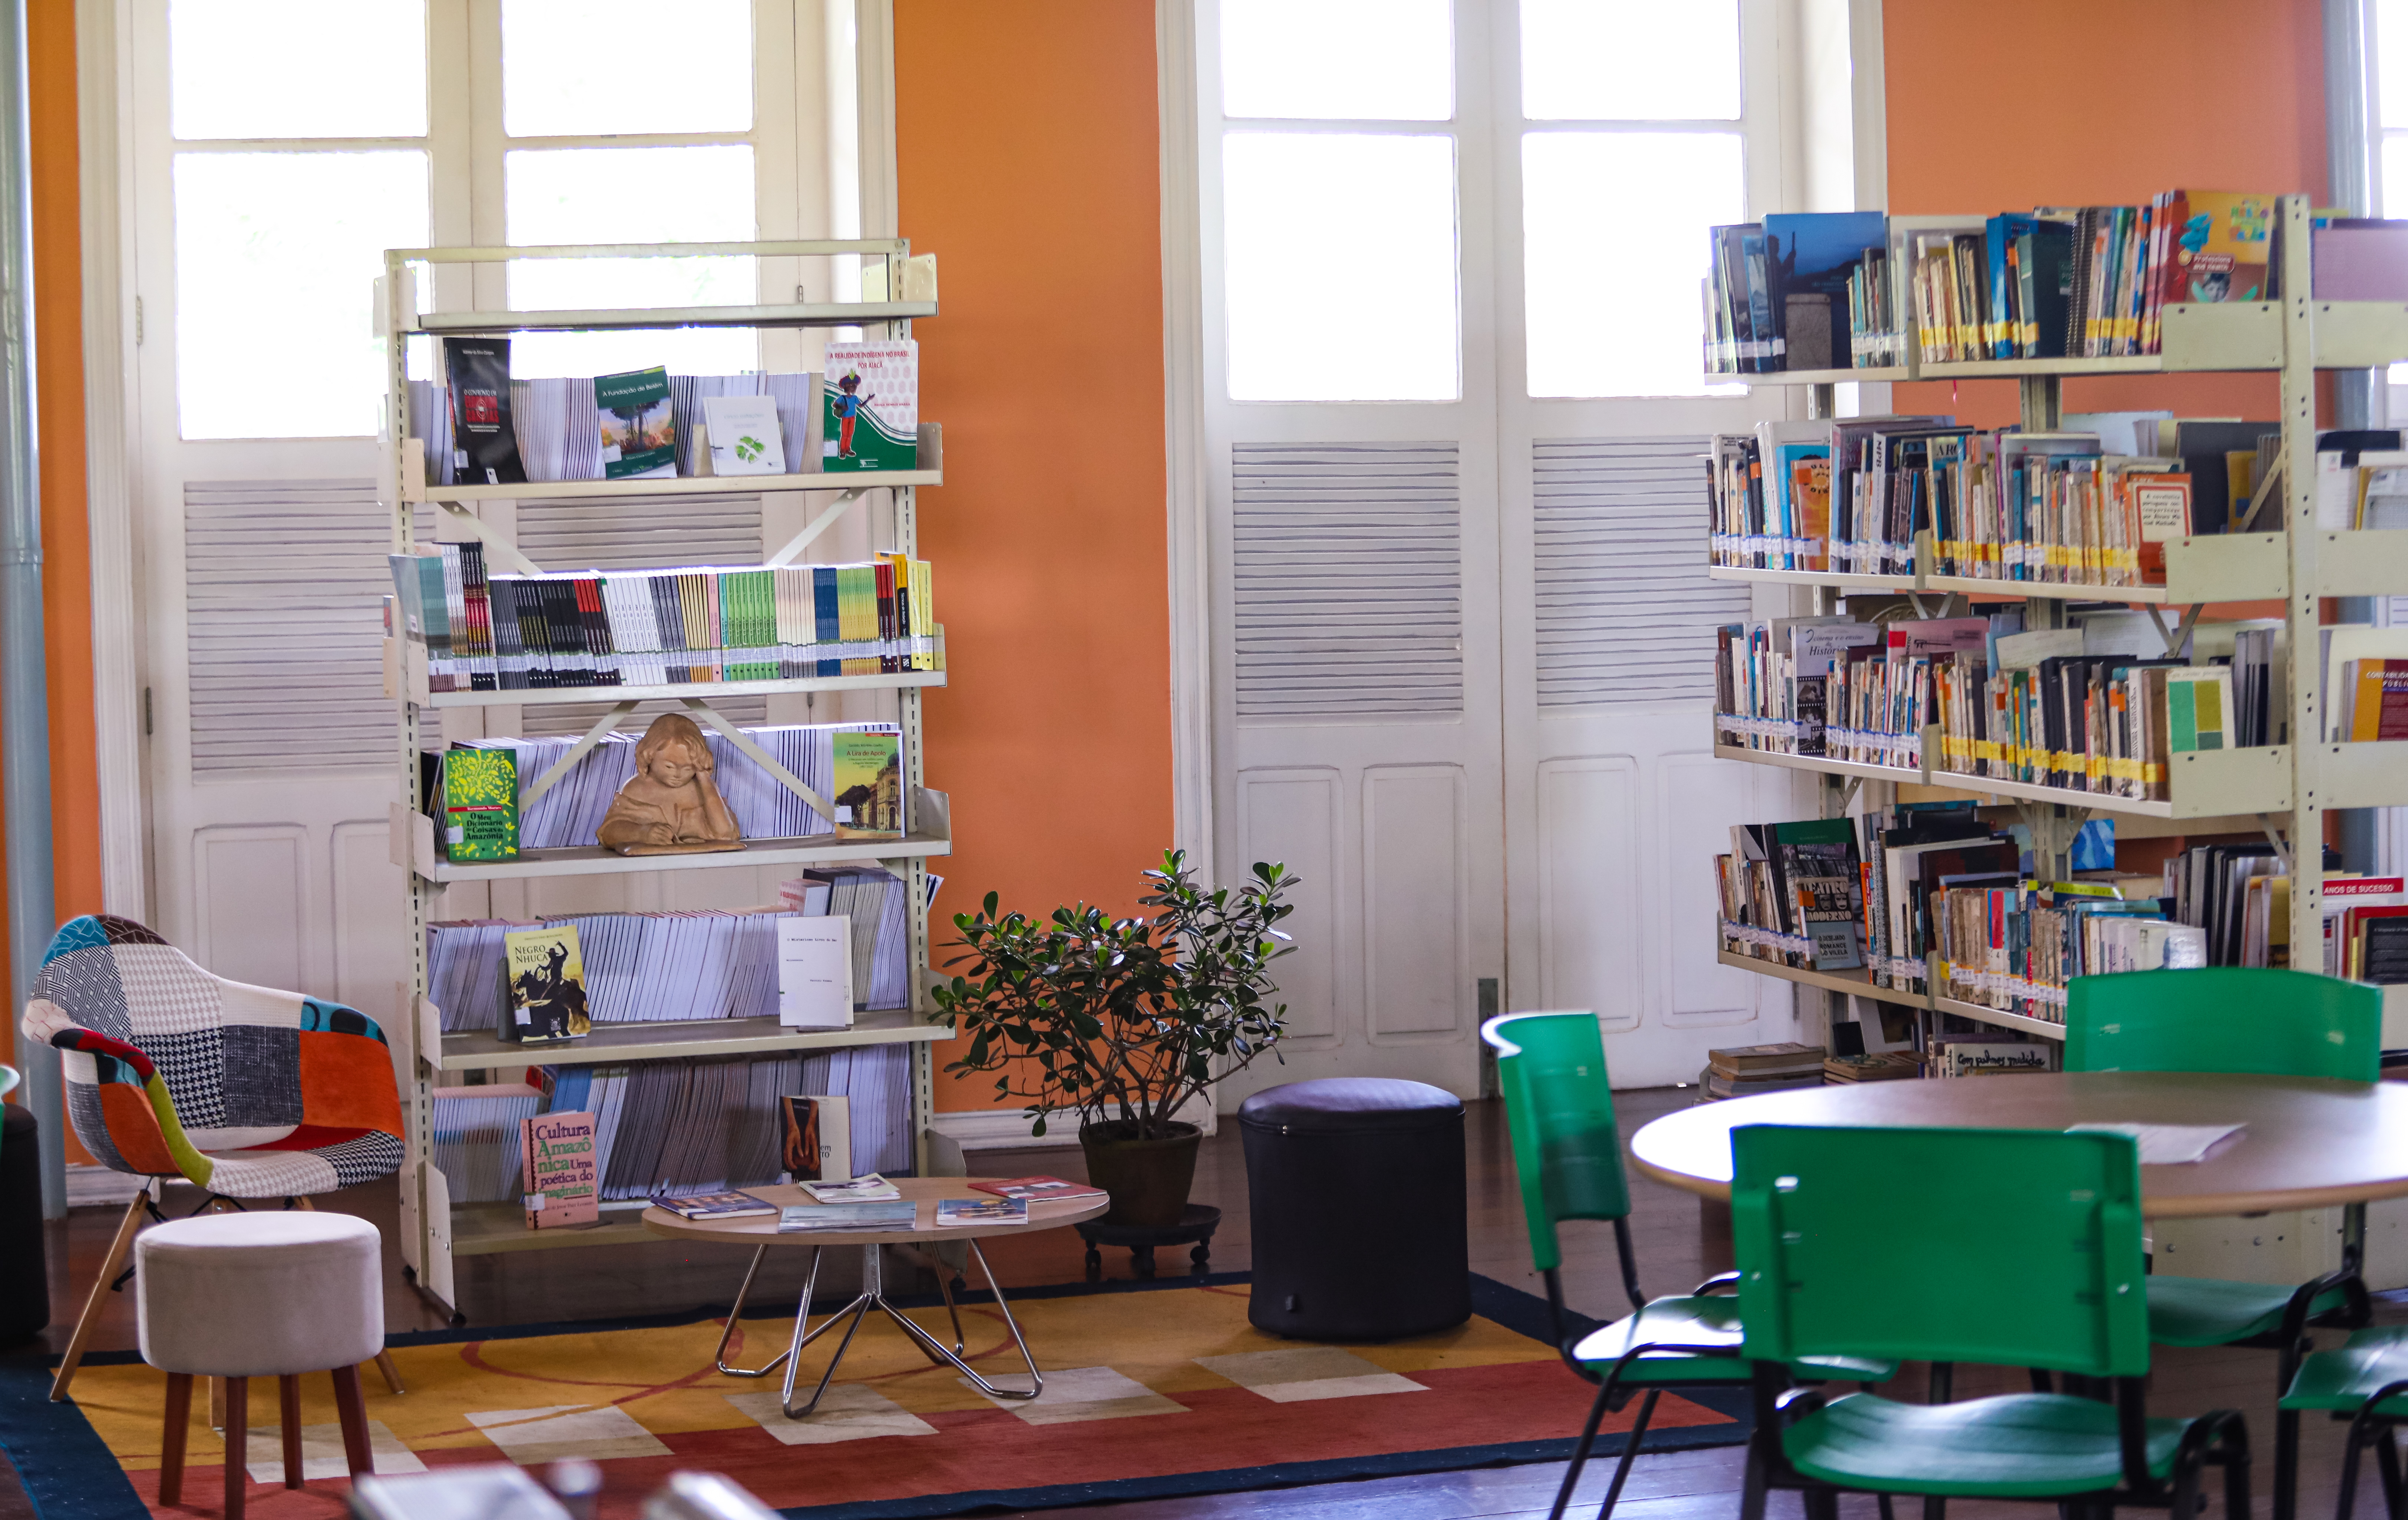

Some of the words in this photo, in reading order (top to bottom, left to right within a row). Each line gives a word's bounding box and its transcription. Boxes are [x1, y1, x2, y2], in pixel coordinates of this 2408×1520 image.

[608, 387, 636, 396] Fundação
[2323, 885, 2346, 894] ANOS
[2346, 885, 2357, 893] DE
[2358, 884, 2395, 893] SUCESSO
[1806, 910, 1852, 921] MODERNO
[515, 945, 546, 955] NEGRO
[516, 954, 548, 964] NHUCA
[1958, 1054, 1973, 1067] Com
[2007, 1050, 2045, 1066] medida
[536, 1122, 591, 1140] Cultura
[536, 1137, 592, 1158] Amazô
[538, 1156, 570, 1174] nica
[570, 1159, 592, 1170] Uma
[541, 1172, 577, 1189] poética
[579, 1169, 594, 1181] do
[539, 1182, 593, 1199] imaginário
